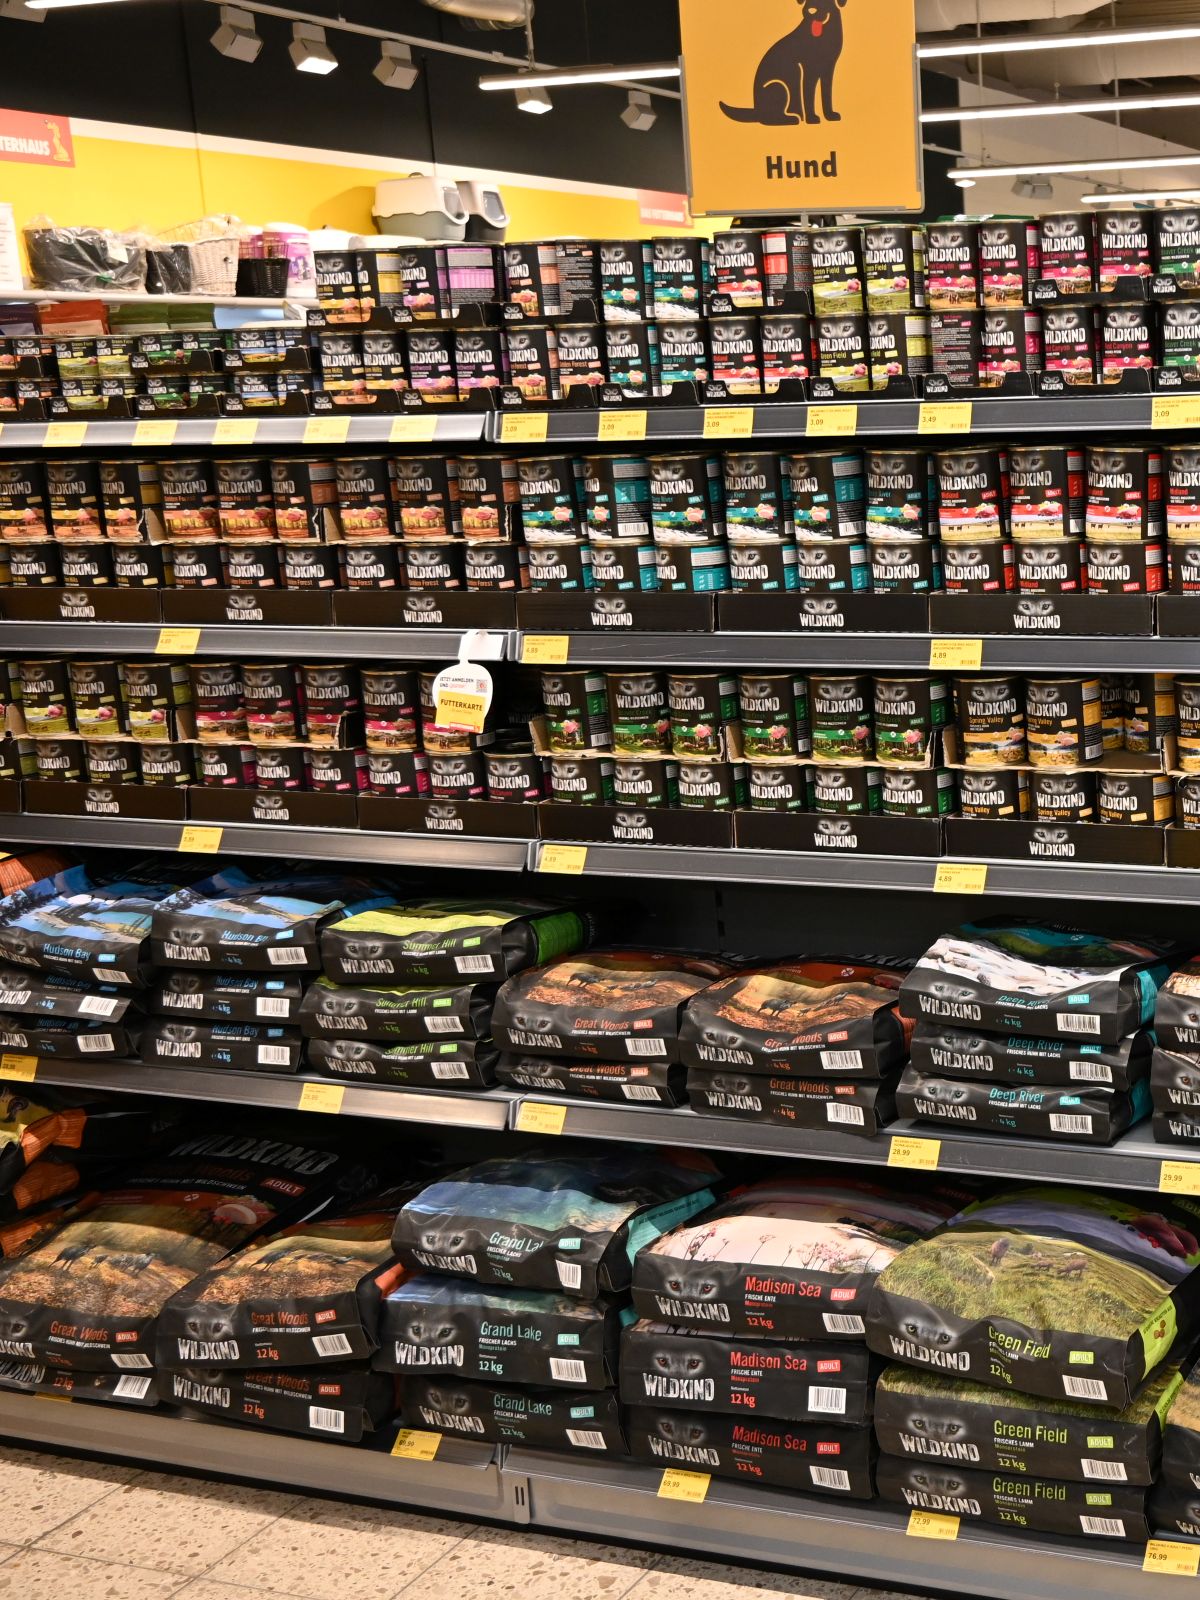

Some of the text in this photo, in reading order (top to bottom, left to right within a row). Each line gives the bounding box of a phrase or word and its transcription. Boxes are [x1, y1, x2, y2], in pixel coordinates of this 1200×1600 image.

[766, 151, 838, 179] Hund
[1041, 235, 1085, 251] WILDKIND
[1101, 232, 1147, 248] WILDKIND
[812, 250, 854, 267] WILDKIND
[868, 473, 913, 489] WILDKIND
[872, 563, 920, 579] WILDKIND
[60, 605, 95, 618] WILDKIND
[226, 607, 263, 621] WILDKIND
[403, 609, 442, 623] WILDKIND
[591, 612, 633, 626] WILDKIND
[799, 613, 844, 627] WILDKIND
[1013, 614, 1060, 630] WILDKIND
[441, 699, 482, 711] FUTTERKARTE
[966, 698, 1016, 717] WILDKIND
[85, 800, 119, 814] WILDKIND
[253, 807, 289, 820] WILDKIND
[425, 817, 463, 830] WILDKIND
[612, 825, 653, 840] WILDKIND
[814, 833, 857, 848] WILDKIND
[1029, 841, 1075, 857] WILDKIND
[163, 941, 210, 962] WILDKIND
[402, 938, 456, 952] Summer Hill
[339, 958, 394, 973] WILDKIND
[919, 995, 981, 1021] WILDKIND
[315, 1014, 368, 1031] WILDKIND
[506, 1027, 562, 1049] WILDKIND
[156, 1039, 201, 1058] WILDKIND
[697, 1044, 754, 1065] WILDKIND
[325, 1056, 376, 1074] WILDKIND
[930, 1048, 993, 1071] WILDKIND
[770, 1078, 829, 1093] Great Woods
[990, 1087, 1045, 1103] Deep River
[915, 1099, 977, 1121] WILDKIND
[1163, 1173, 1182, 1181] 29,99
[266, 1179, 300, 1194] ADULT
[745, 1276, 821, 1297] Madison Sea
[251, 1311, 308, 1325] Great Woods
[481, 1321, 541, 1341] Grand Lake
[177, 1338, 240, 1360] WILDKIND
[395, 1340, 464, 1367] WILDKIND
[889, 1335, 971, 1372] WILDKIND
[730, 1352, 807, 1371] Madison Sea
[643, 1373, 714, 1400] WILDKIND
[243, 1404, 264, 1418] 12 kg
[994, 1420, 1067, 1445] Green Field
[651, 1438, 720, 1466] WILDKIND
[993, 1478, 1066, 1501] Green Field
[912, 1518, 930, 1526] 72,99
[1148, 1553, 1167, 1561] 76,99
